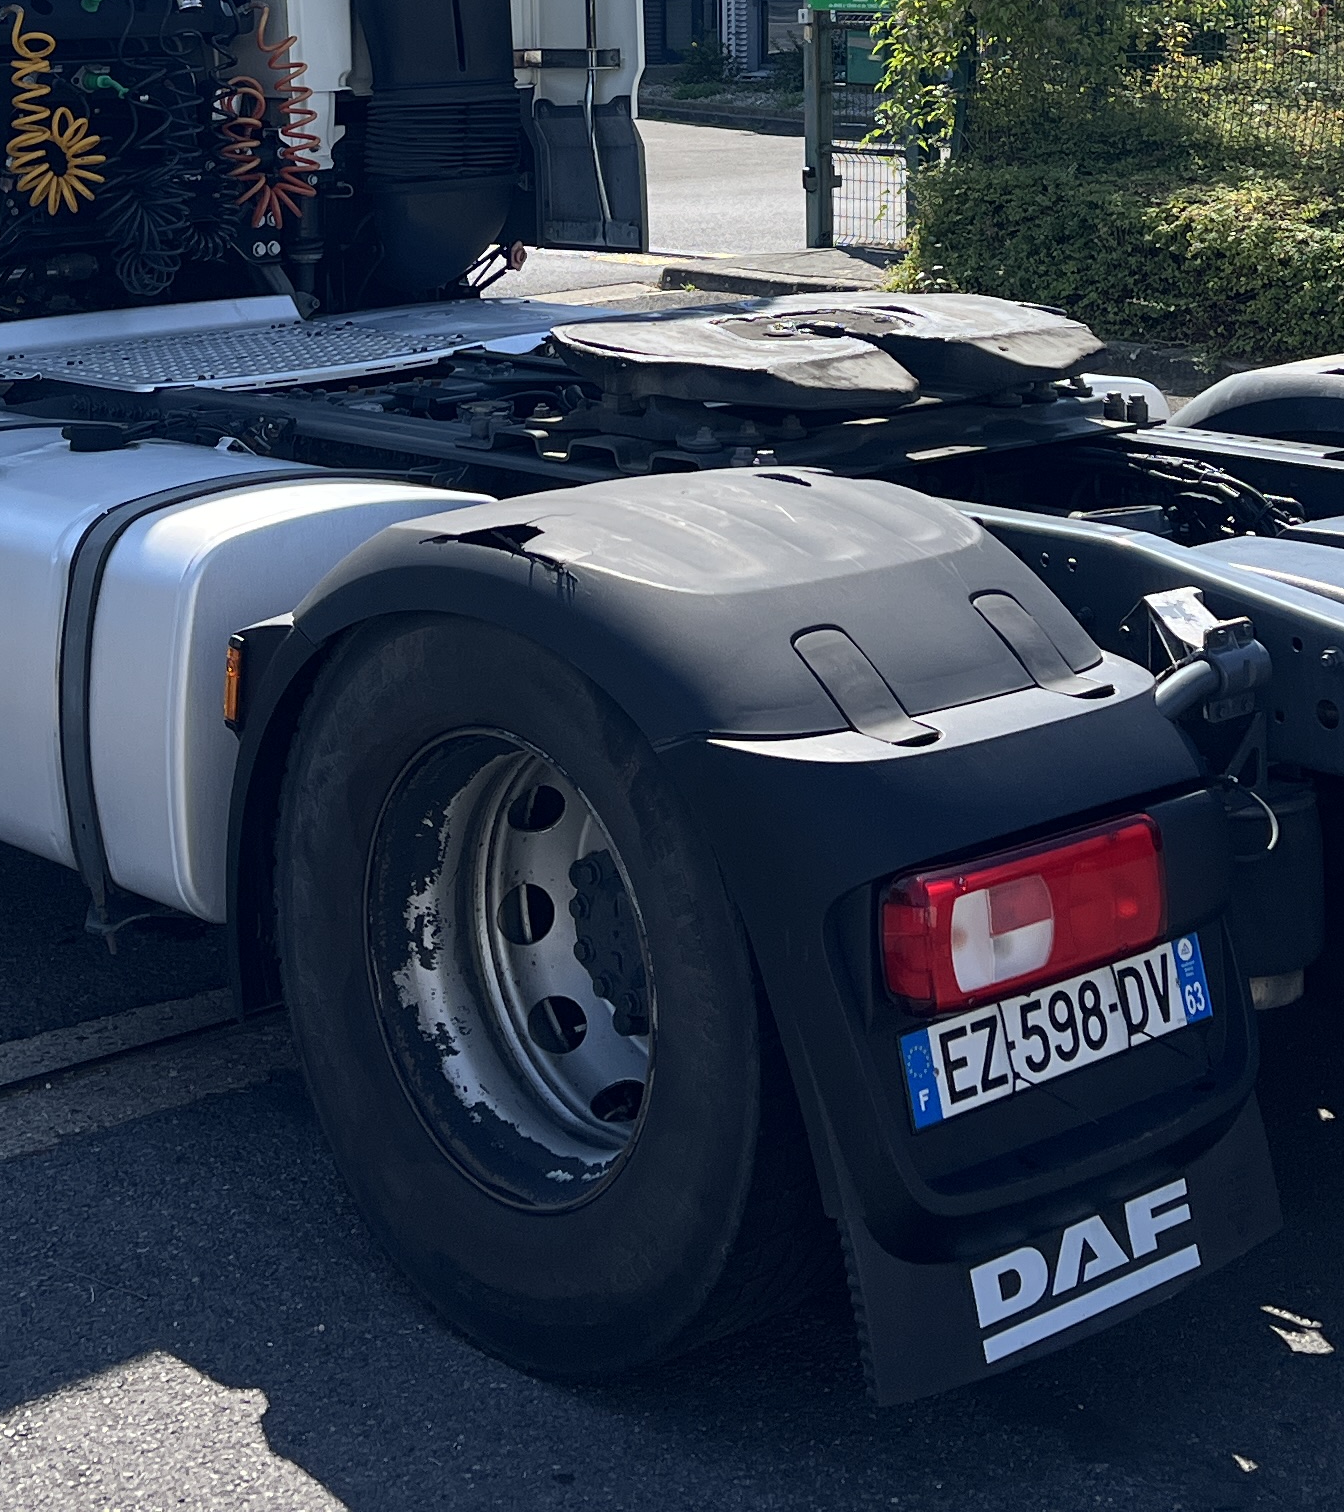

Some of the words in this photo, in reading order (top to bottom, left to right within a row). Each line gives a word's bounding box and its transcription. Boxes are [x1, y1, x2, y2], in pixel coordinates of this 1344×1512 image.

[939, 952, 1172, 1106] EZ-598-DV
[1184, 981, 1206, 1015] 63
[917, 1089, 930, 1113] F
[969, 1178, 1192, 1329] DAF
